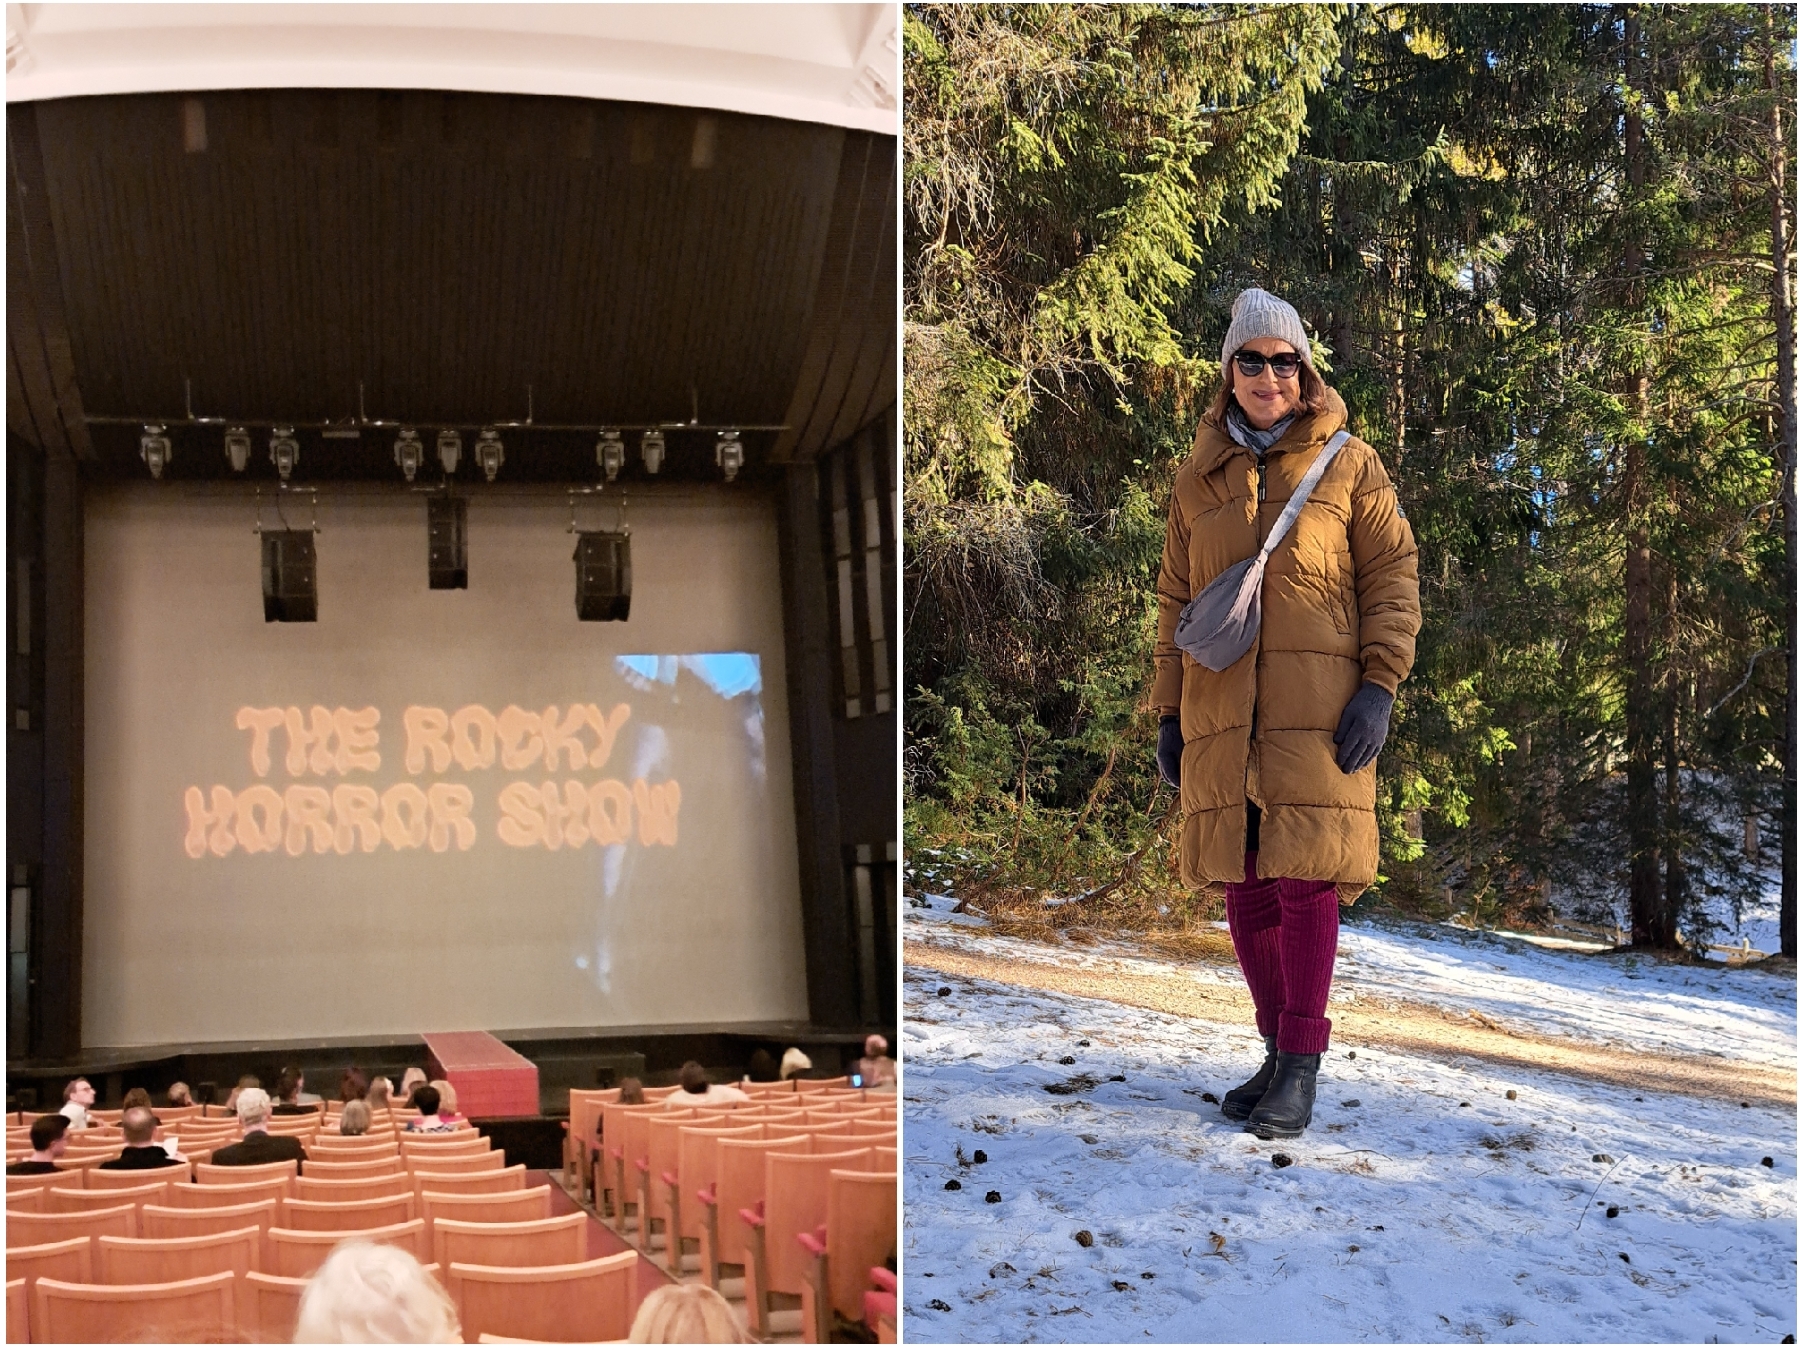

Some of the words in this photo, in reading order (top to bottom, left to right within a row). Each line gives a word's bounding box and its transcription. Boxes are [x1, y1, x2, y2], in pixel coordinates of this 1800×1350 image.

[237, 706, 381, 776] THE
[404, 704, 630, 774] ROCKY
[185, 785, 477, 858] HORROR
[498, 779, 680, 850] SHOW
